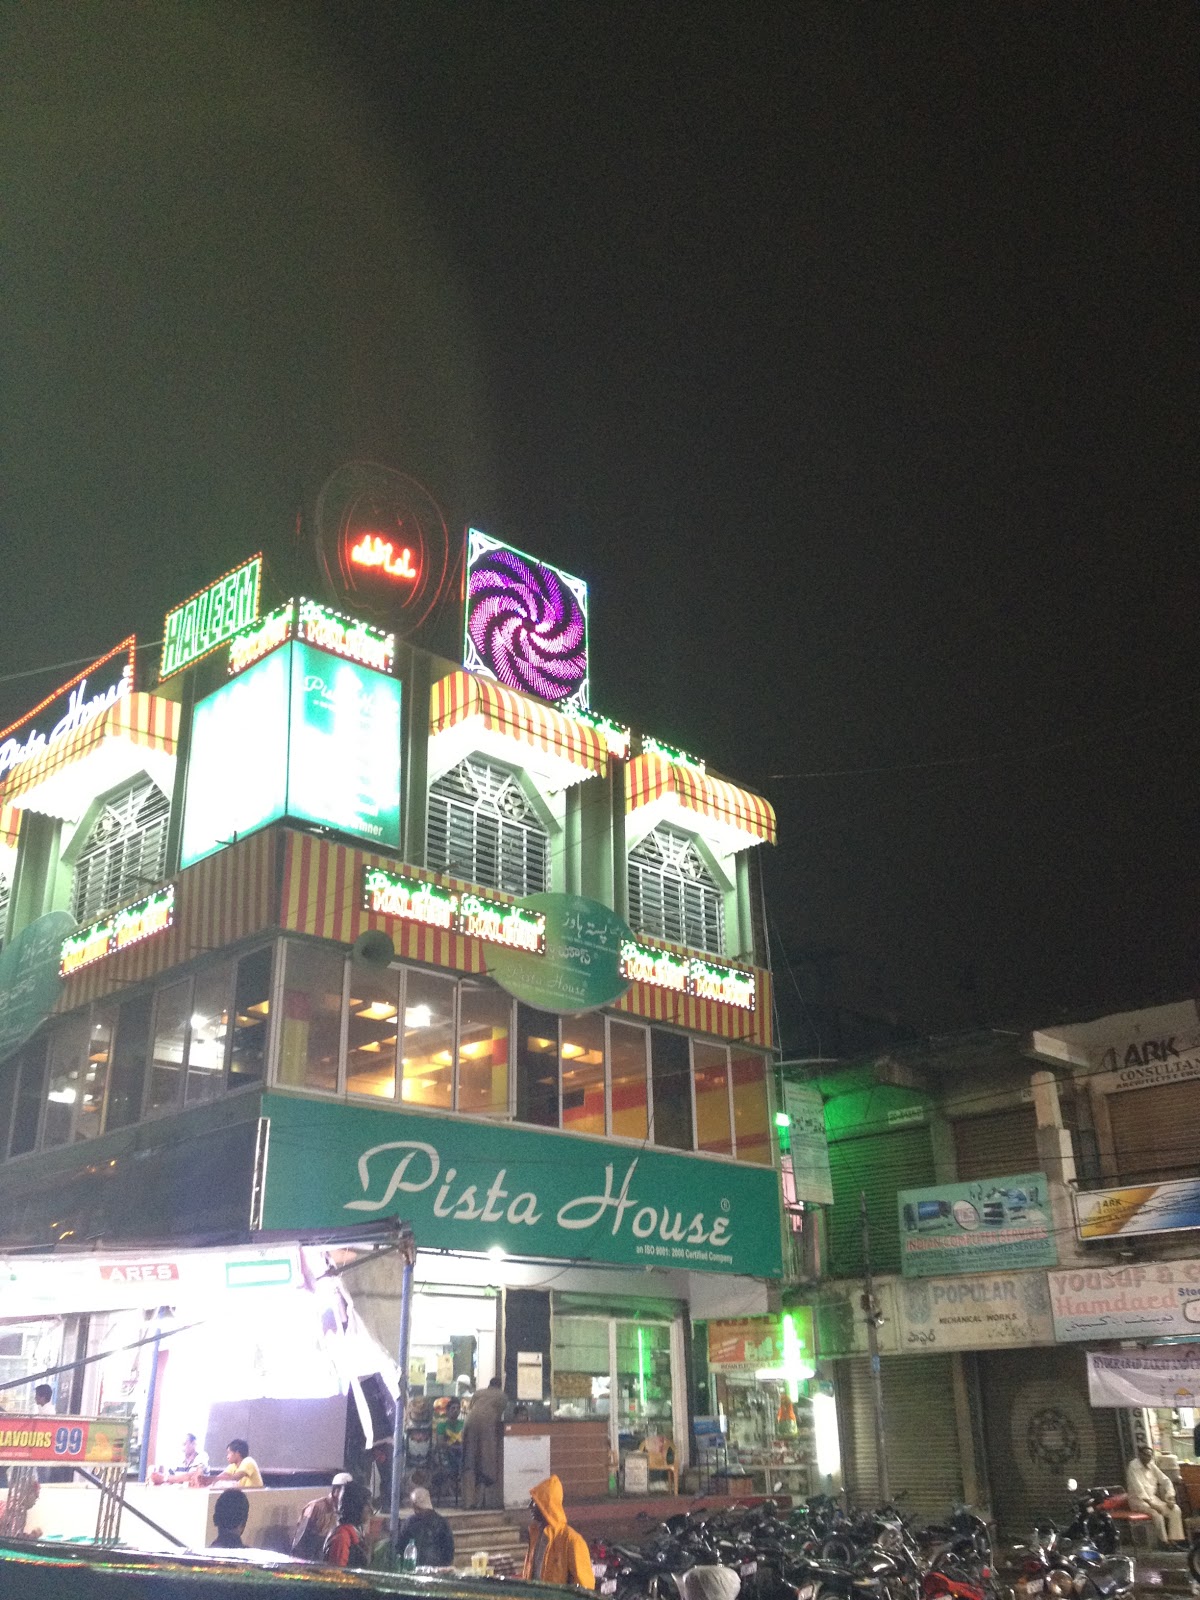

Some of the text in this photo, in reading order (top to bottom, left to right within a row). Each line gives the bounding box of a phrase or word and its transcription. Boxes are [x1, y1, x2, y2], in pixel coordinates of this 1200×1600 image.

[161, 559, 259, 676] HALEEM
[548, 974, 586, 997] House
[1125, 1037, 1180, 1067] ARK
[343, 1141, 733, 1247] Pista House
[1102, 1199, 1122, 1208] ARK
[645, 1245, 655, 1256] ISO
[686, 1249, 708, 1261] Certified
[709, 1252, 733, 1265] Company
[907, 1235, 940, 1252] INDIAN
[933, 1280, 1017, 1305] POPULAR
[939, 1314, 983, 1325] MECHANICAL
[54, 1427, 83, 1456] 99
